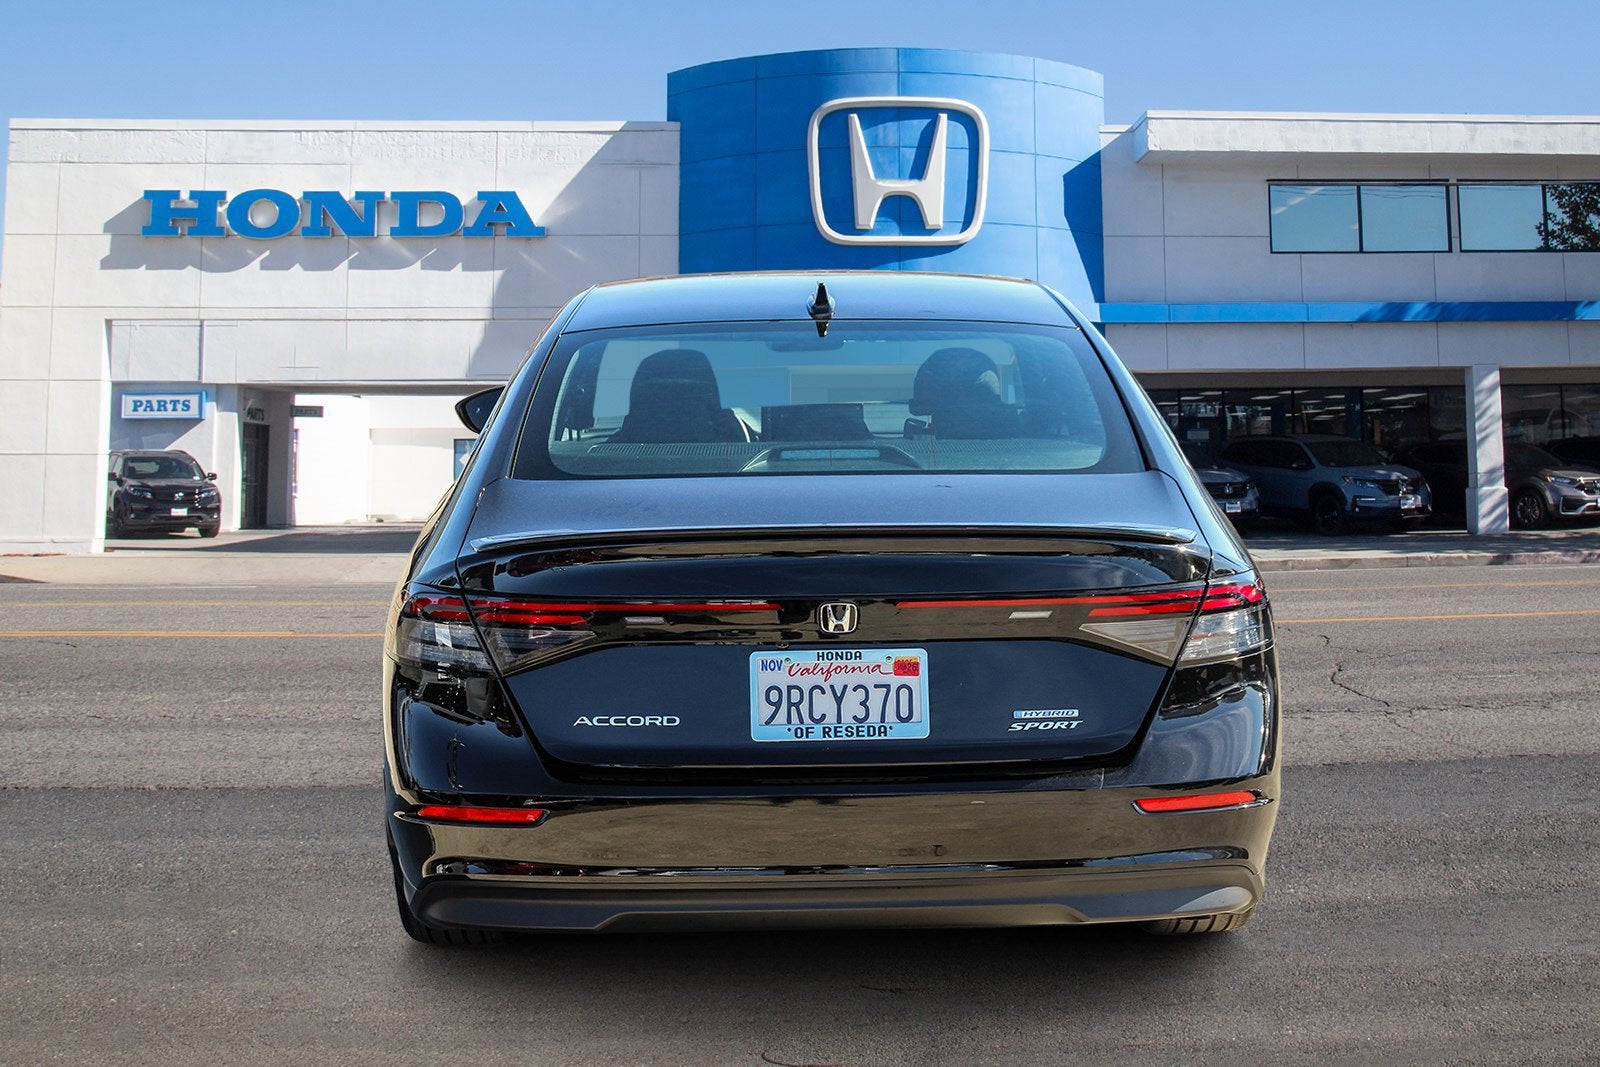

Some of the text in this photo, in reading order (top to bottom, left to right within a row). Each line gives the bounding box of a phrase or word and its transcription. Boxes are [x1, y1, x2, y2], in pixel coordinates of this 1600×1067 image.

[141, 188, 548, 240] HONDA
[131, 399, 192, 412] PARTS
[816, 651, 863, 661] HONDA
[760, 659, 783, 672] NOV
[787, 662, 894, 682] California
[764, 684, 914, 725] 9RCY370
[573, 716, 681, 726] ACCORD
[1007, 720, 1084, 732] SPORT
[794, 725, 889, 739] OF RESEDA
